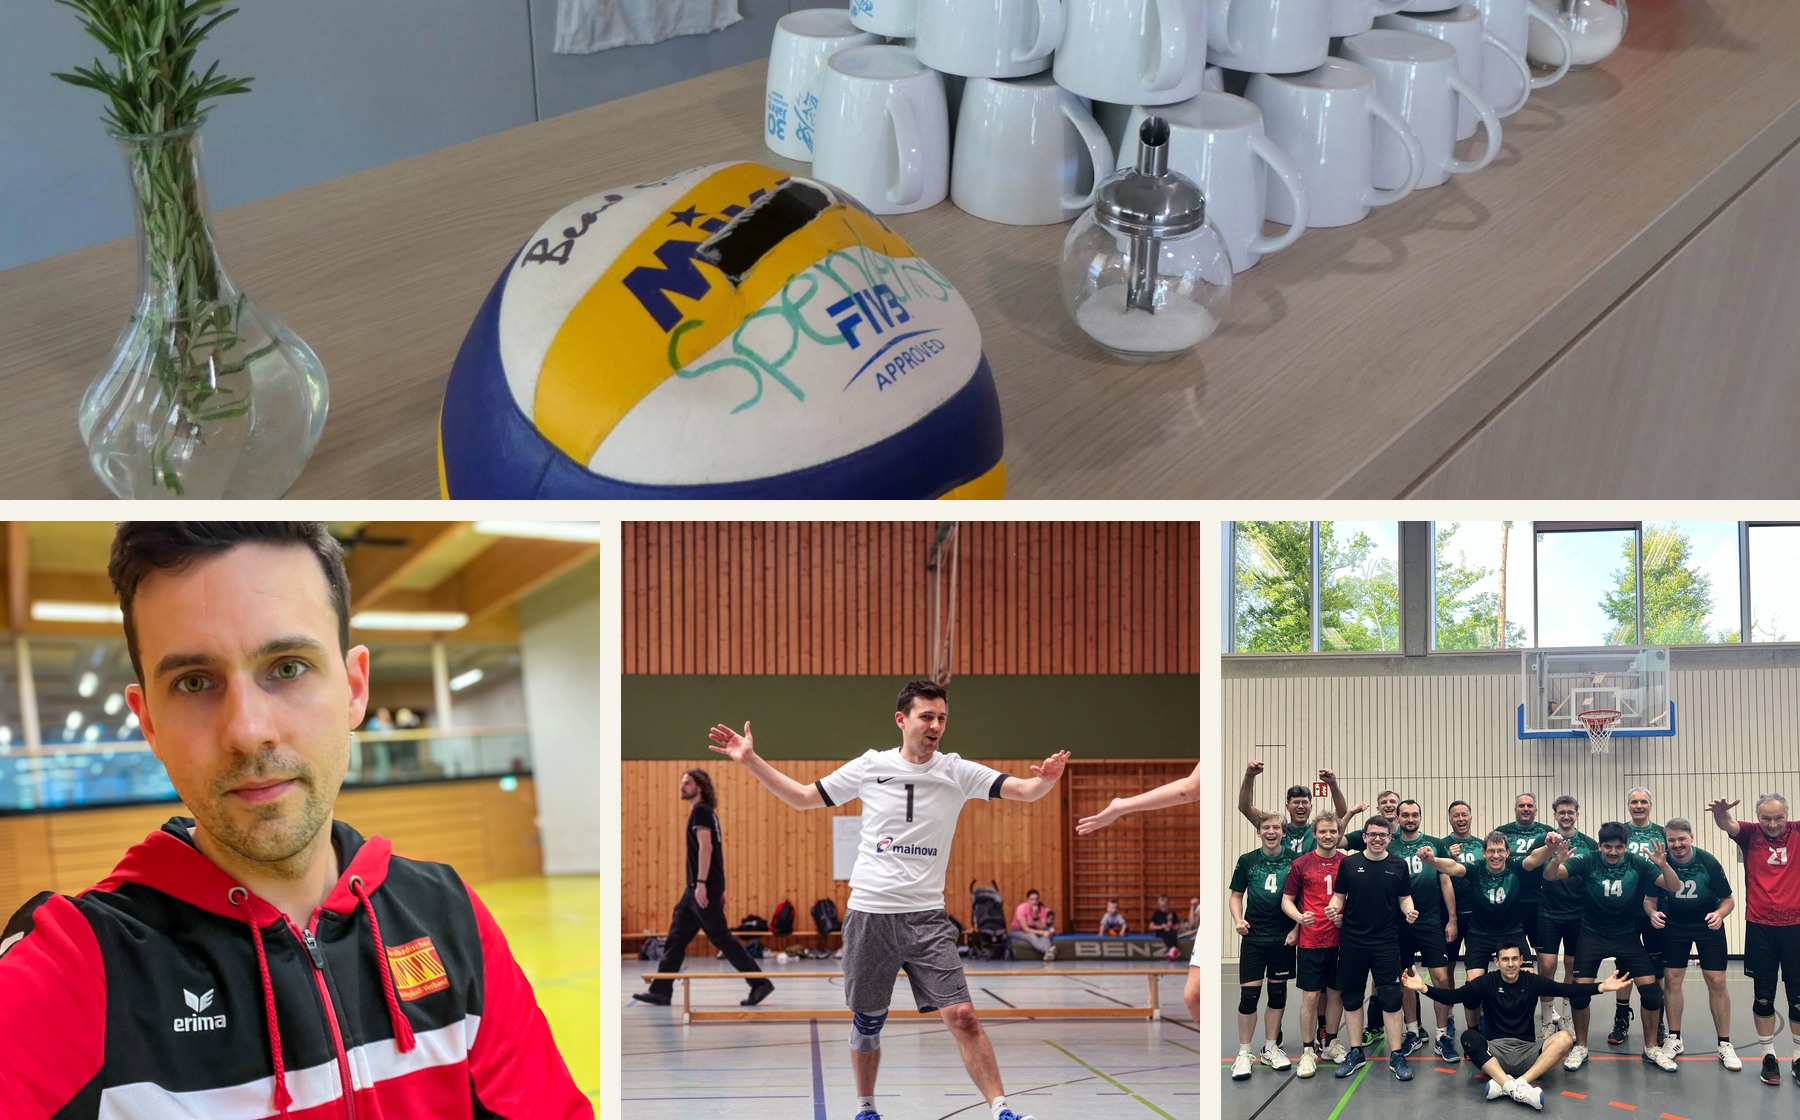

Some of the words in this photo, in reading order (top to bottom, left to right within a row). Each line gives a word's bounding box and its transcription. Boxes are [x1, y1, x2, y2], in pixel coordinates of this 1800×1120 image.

[876, 338, 945, 391] APPROVED
[905, 783, 914, 822] 1
[893, 844, 938, 857] mainova
[1404, 855, 1423, 875] 16
[1264, 873, 1278, 893] 4
[1323, 874, 1333, 895] 1
[1602, 879, 1623, 897] 14
[1675, 879, 1698, 899] 22
[1075, 941, 1169, 957] BENZ
[173, 1013, 227, 1032] erima
